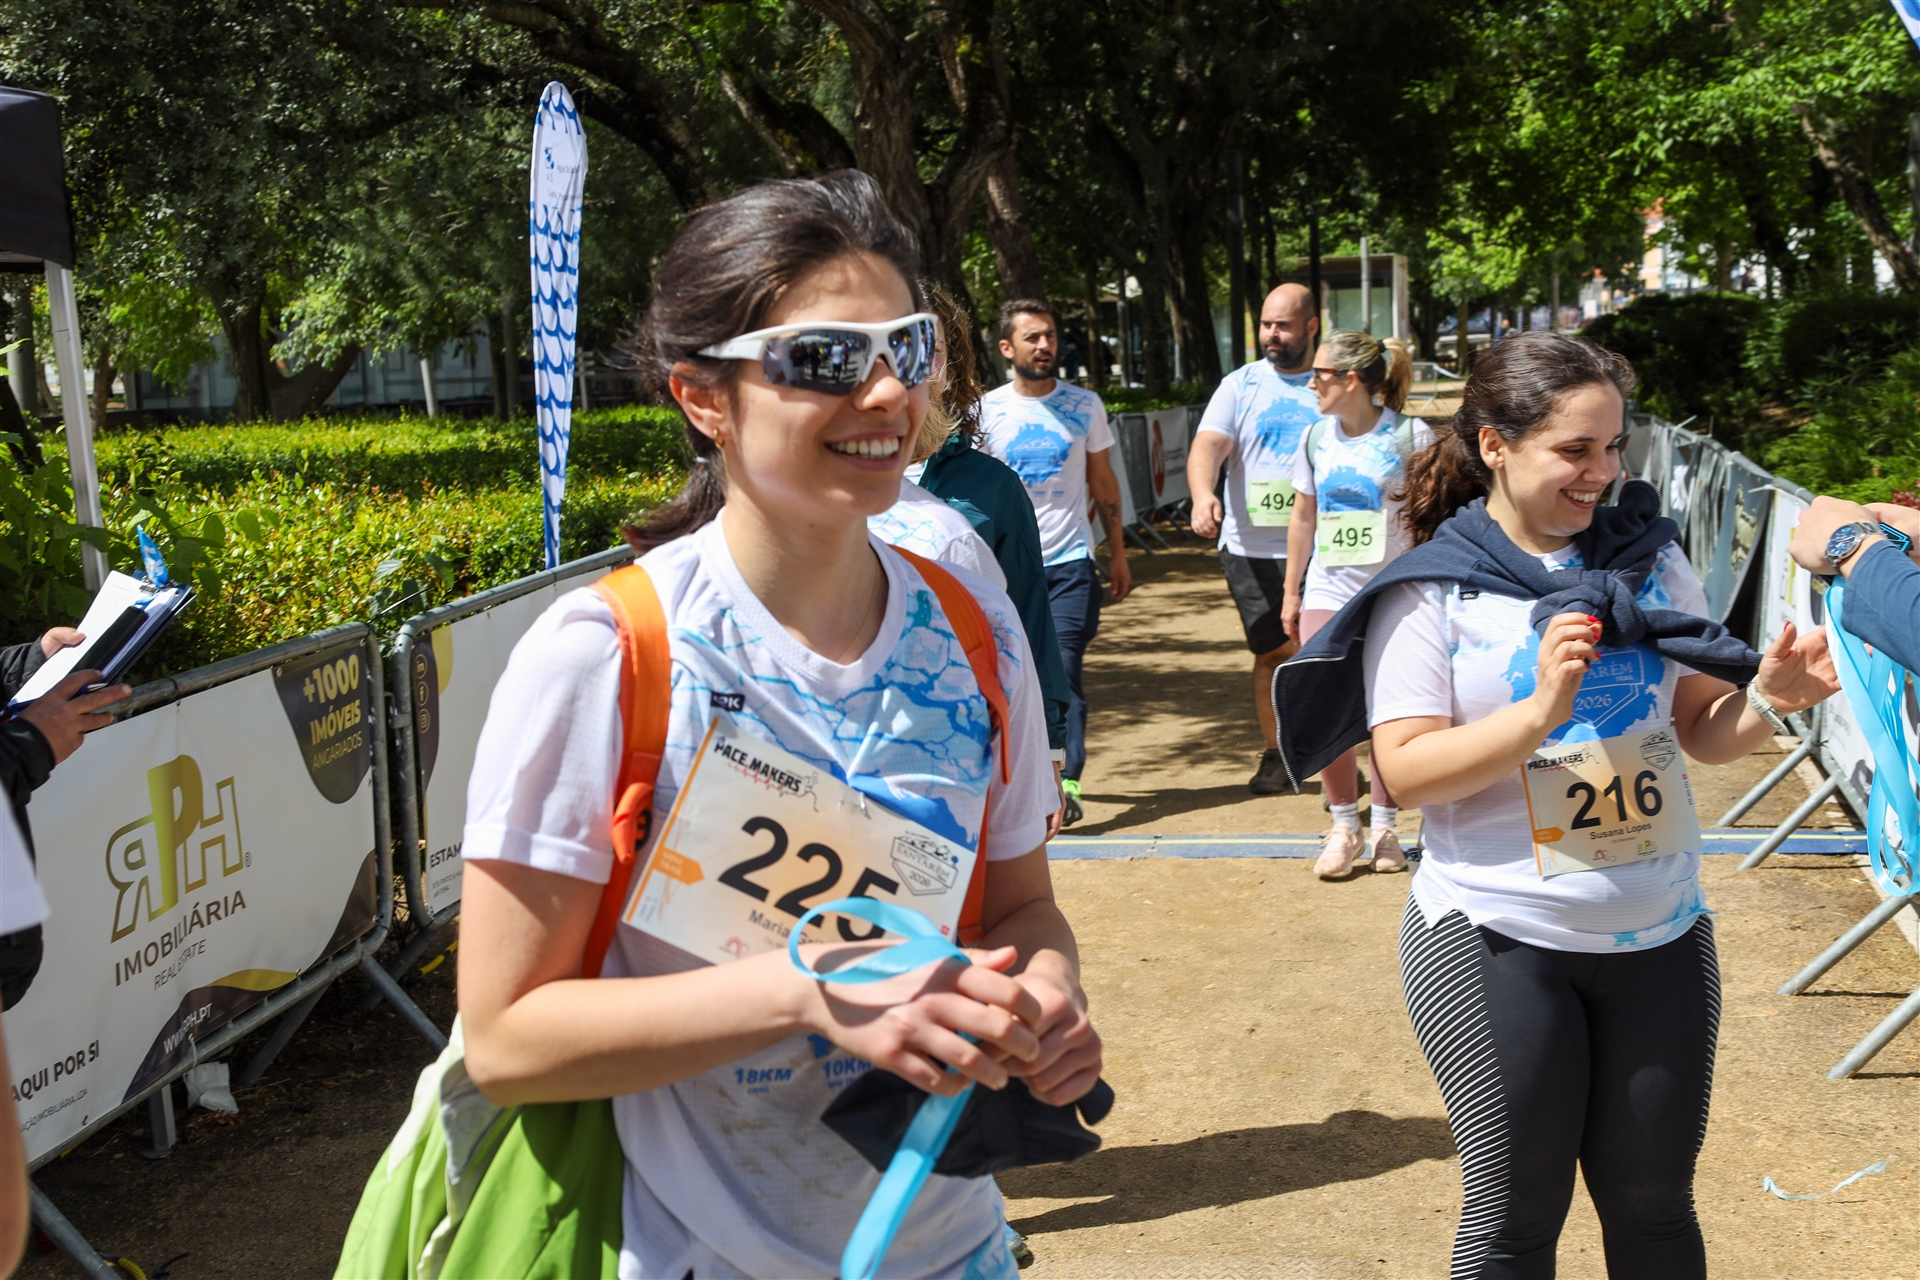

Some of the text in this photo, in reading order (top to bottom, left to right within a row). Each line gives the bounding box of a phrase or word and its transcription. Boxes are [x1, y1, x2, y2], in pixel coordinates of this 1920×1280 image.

[1261, 493, 1295, 510] 494
[1332, 527, 1372, 547] 495
[303, 654, 359, 704] +1000
[1586, 661, 1634, 680] ARÉM
[1574, 694, 1613, 711] 2026
[310, 699, 361, 745] IMÓVEIS
[312, 731, 362, 771] ANGARIADOS
[1566, 770, 1662, 830] 216
[1589, 823, 1653, 840] Susana Lopes
[430, 841, 462, 868] ESTAM
[718, 816, 900, 942] 225
[749, 909, 791, 938] Maria
[115, 890, 247, 987] IMOBILIÁRIA
[154, 960, 178, 990] REAL
[12, 1039, 100, 1103] AQUI POR SI
[735, 1068, 792, 1084] 18KM
[823, 1057, 872, 1078] 10KM
